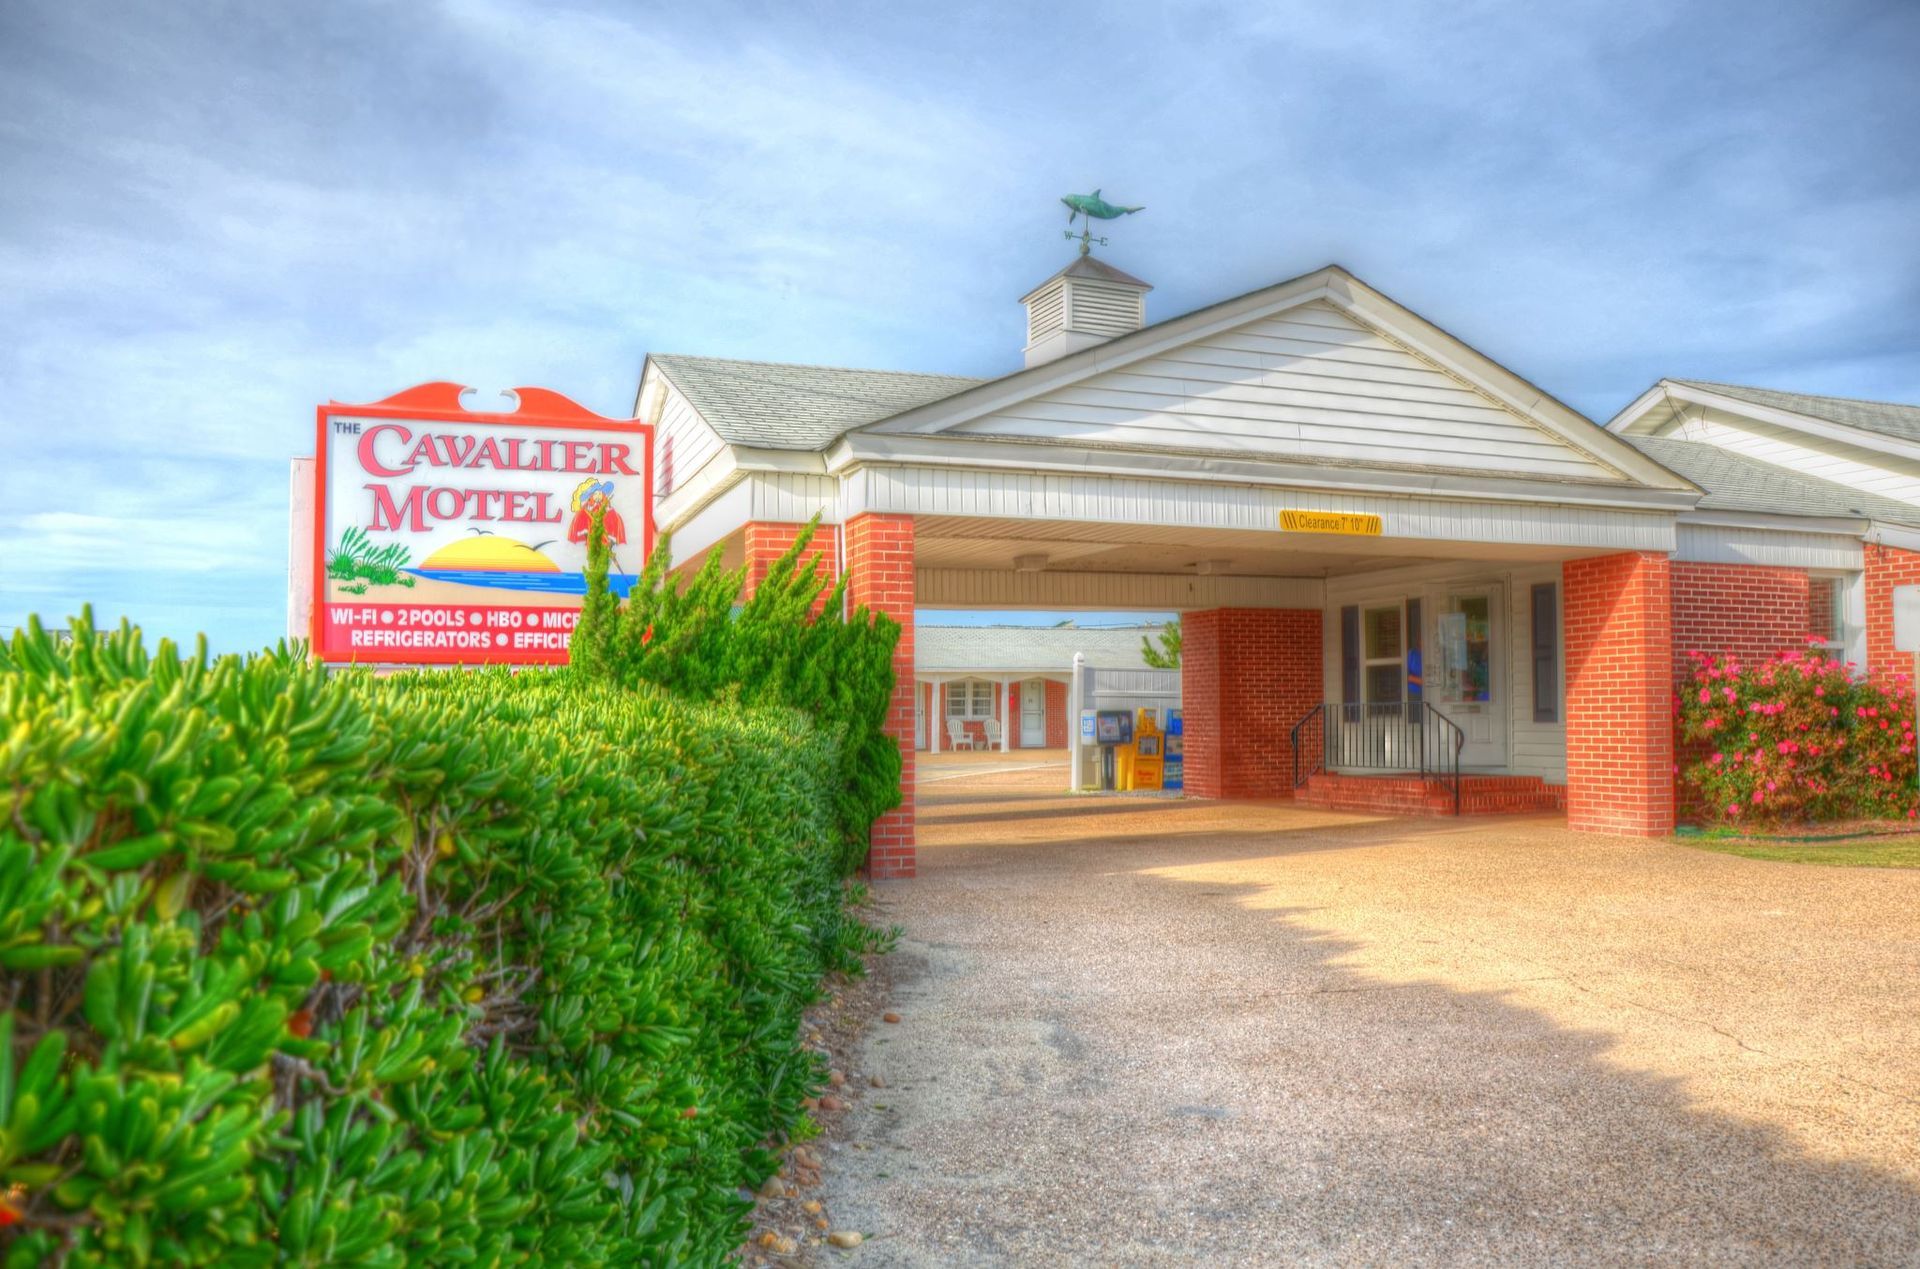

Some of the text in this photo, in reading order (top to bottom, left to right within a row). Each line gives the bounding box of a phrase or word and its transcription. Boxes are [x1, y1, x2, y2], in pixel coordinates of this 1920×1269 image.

[334, 421, 361, 434] THE
[357, 424, 640, 477] CAVALIER
[363, 484, 563, 532] MOTEL
[331, 608, 377, 625] WI-FI
[486, 611, 522, 628] HBO
[351, 629, 491, 648] REFRIGERATORS
